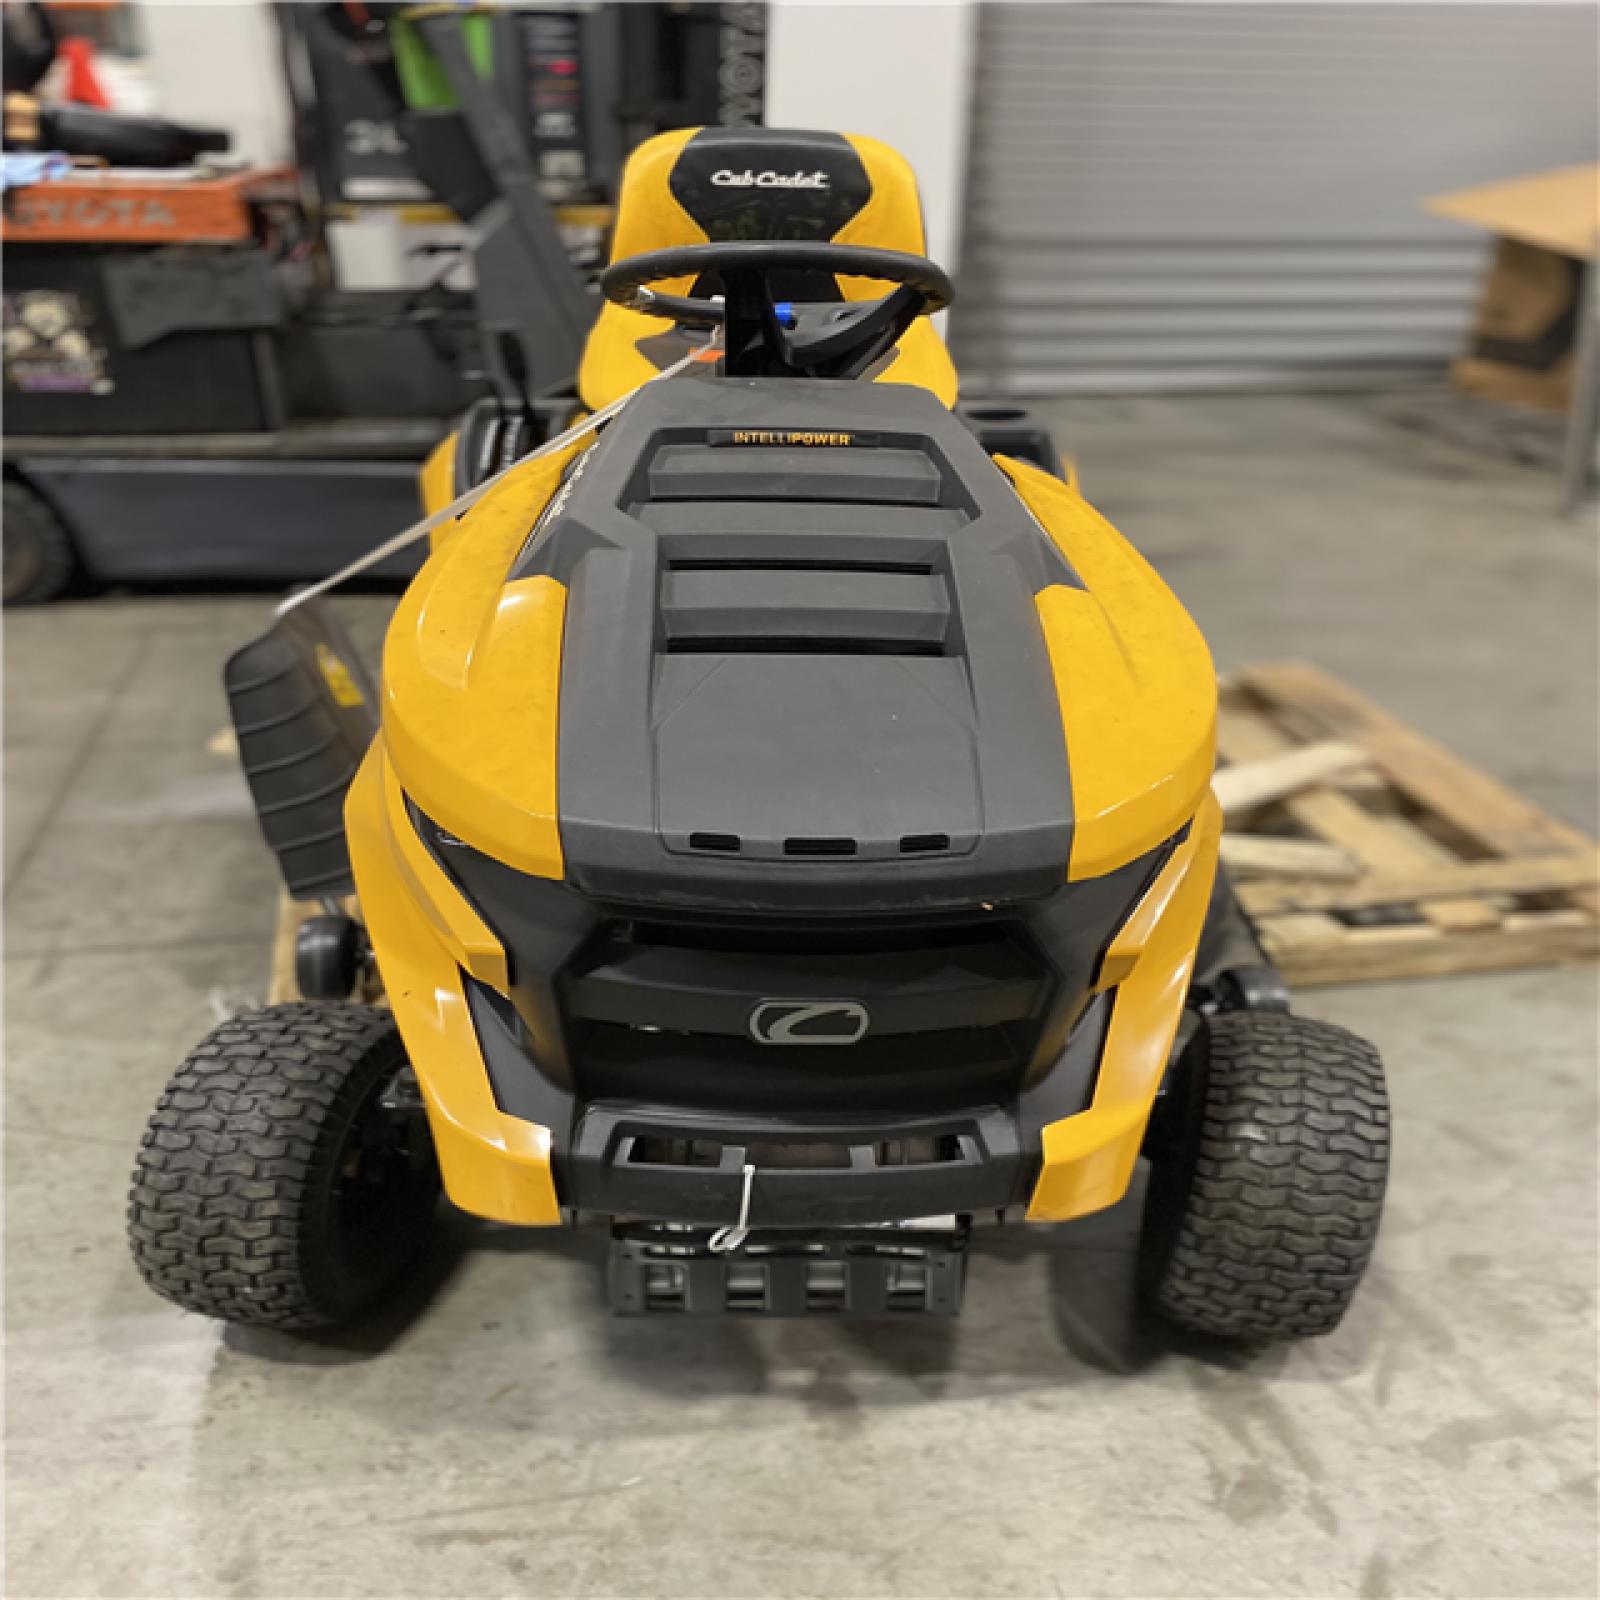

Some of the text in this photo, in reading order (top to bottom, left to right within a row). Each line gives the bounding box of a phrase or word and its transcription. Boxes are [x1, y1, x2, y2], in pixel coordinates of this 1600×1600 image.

[711, 169, 830, 188] Cub Cadet
[732, 431, 852, 446] INTELLIPOWER
